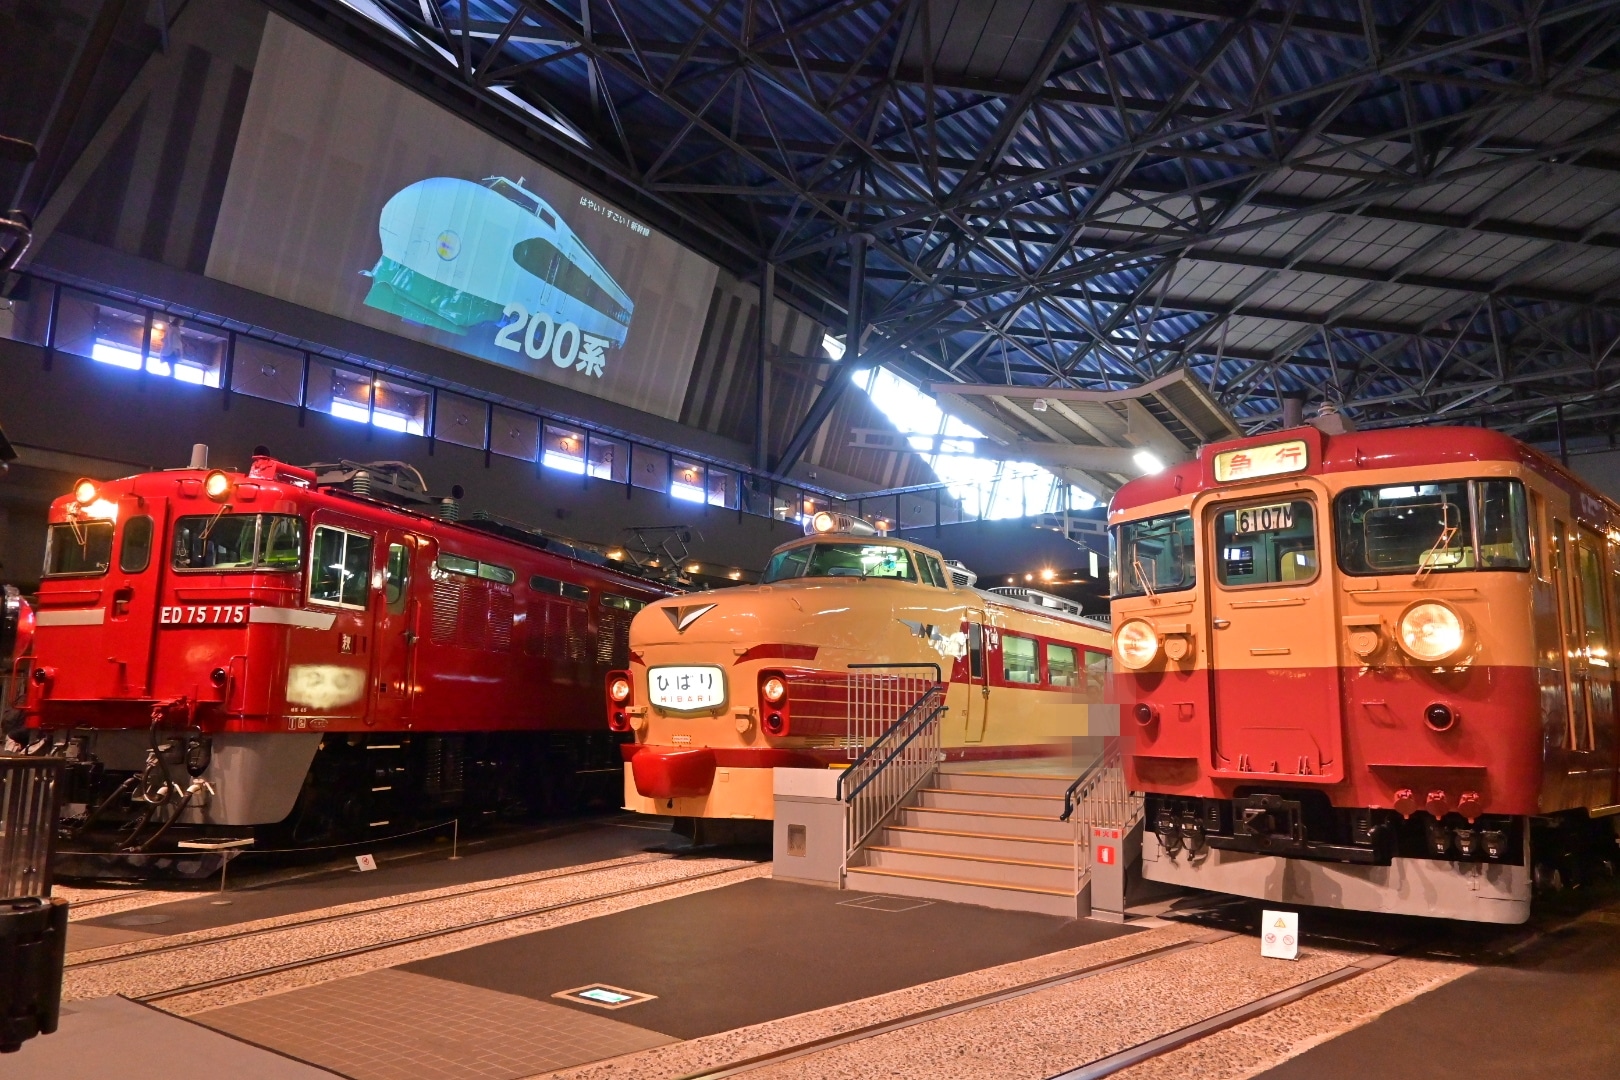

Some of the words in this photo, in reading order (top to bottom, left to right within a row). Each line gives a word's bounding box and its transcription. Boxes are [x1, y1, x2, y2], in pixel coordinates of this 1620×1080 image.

[494, 301, 610, 378] 200系
[1229, 446, 1302, 476] 急行
[160, 606, 182, 623] ED
[187, 606, 207, 623] 75
[213, 606, 244, 623] 775
[657, 673, 713, 691] ひばり
[660, 695, 711, 703] HIBARI
